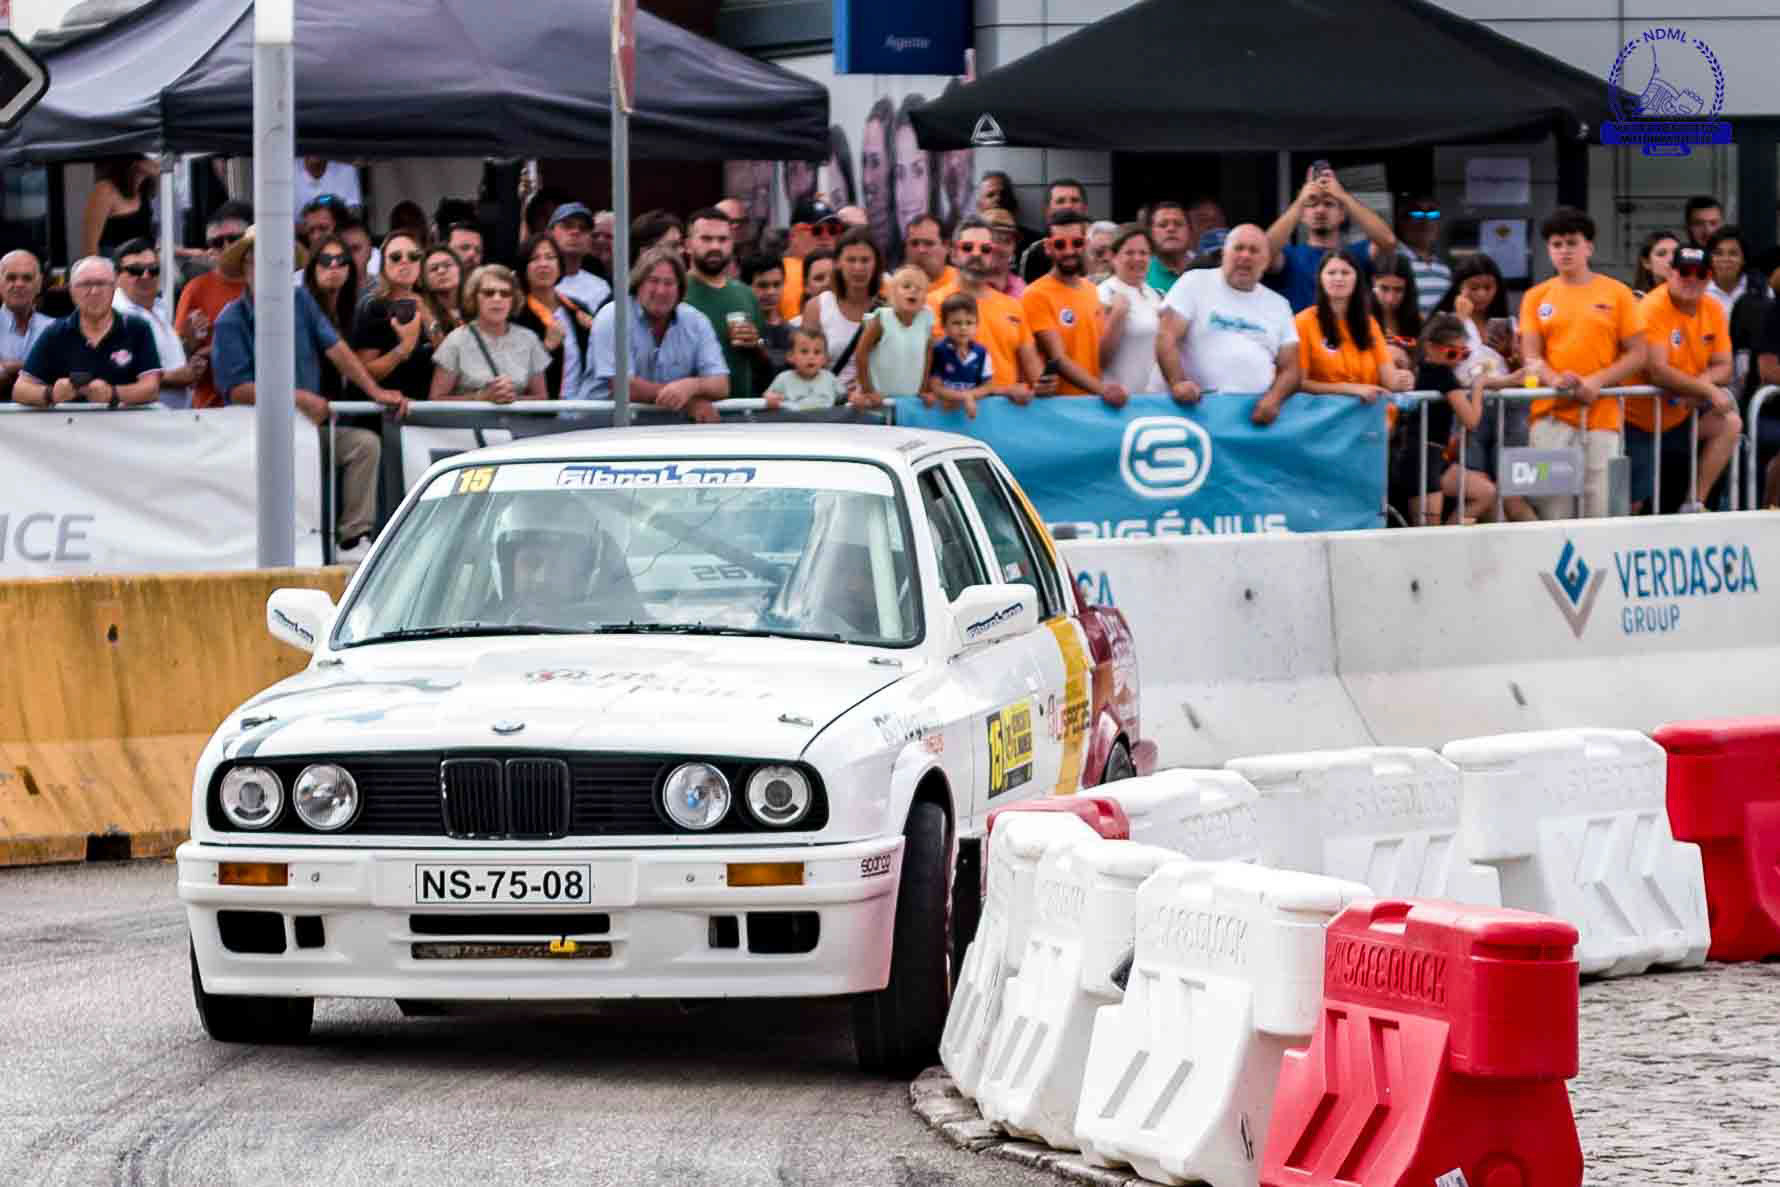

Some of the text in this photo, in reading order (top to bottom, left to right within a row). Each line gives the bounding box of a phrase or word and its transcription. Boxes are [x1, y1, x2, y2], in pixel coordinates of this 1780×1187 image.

[459, 468, 496, 492] 15
[1621, 605, 1681, 635] GROUP
[422, 869, 584, 900] NS-75-08
